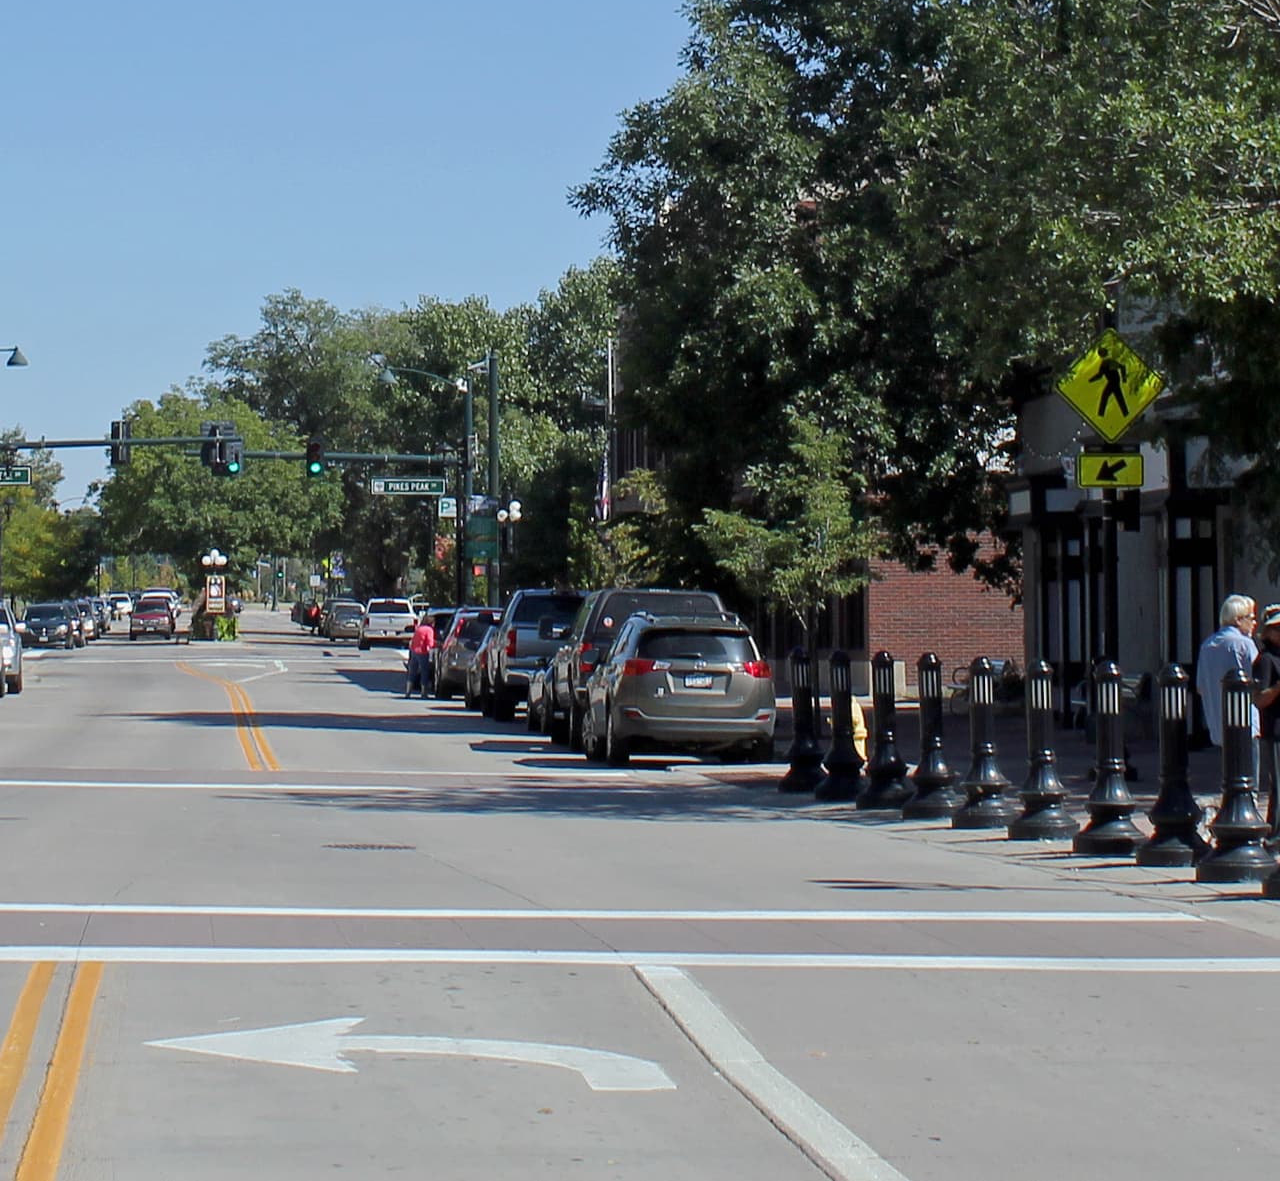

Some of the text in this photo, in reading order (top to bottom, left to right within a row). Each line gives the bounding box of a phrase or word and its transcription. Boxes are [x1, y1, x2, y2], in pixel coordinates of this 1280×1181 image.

[388, 483, 409, 491] PIKES
[411, 483, 430, 491] PEAK
[441, 501, 450, 513] P
